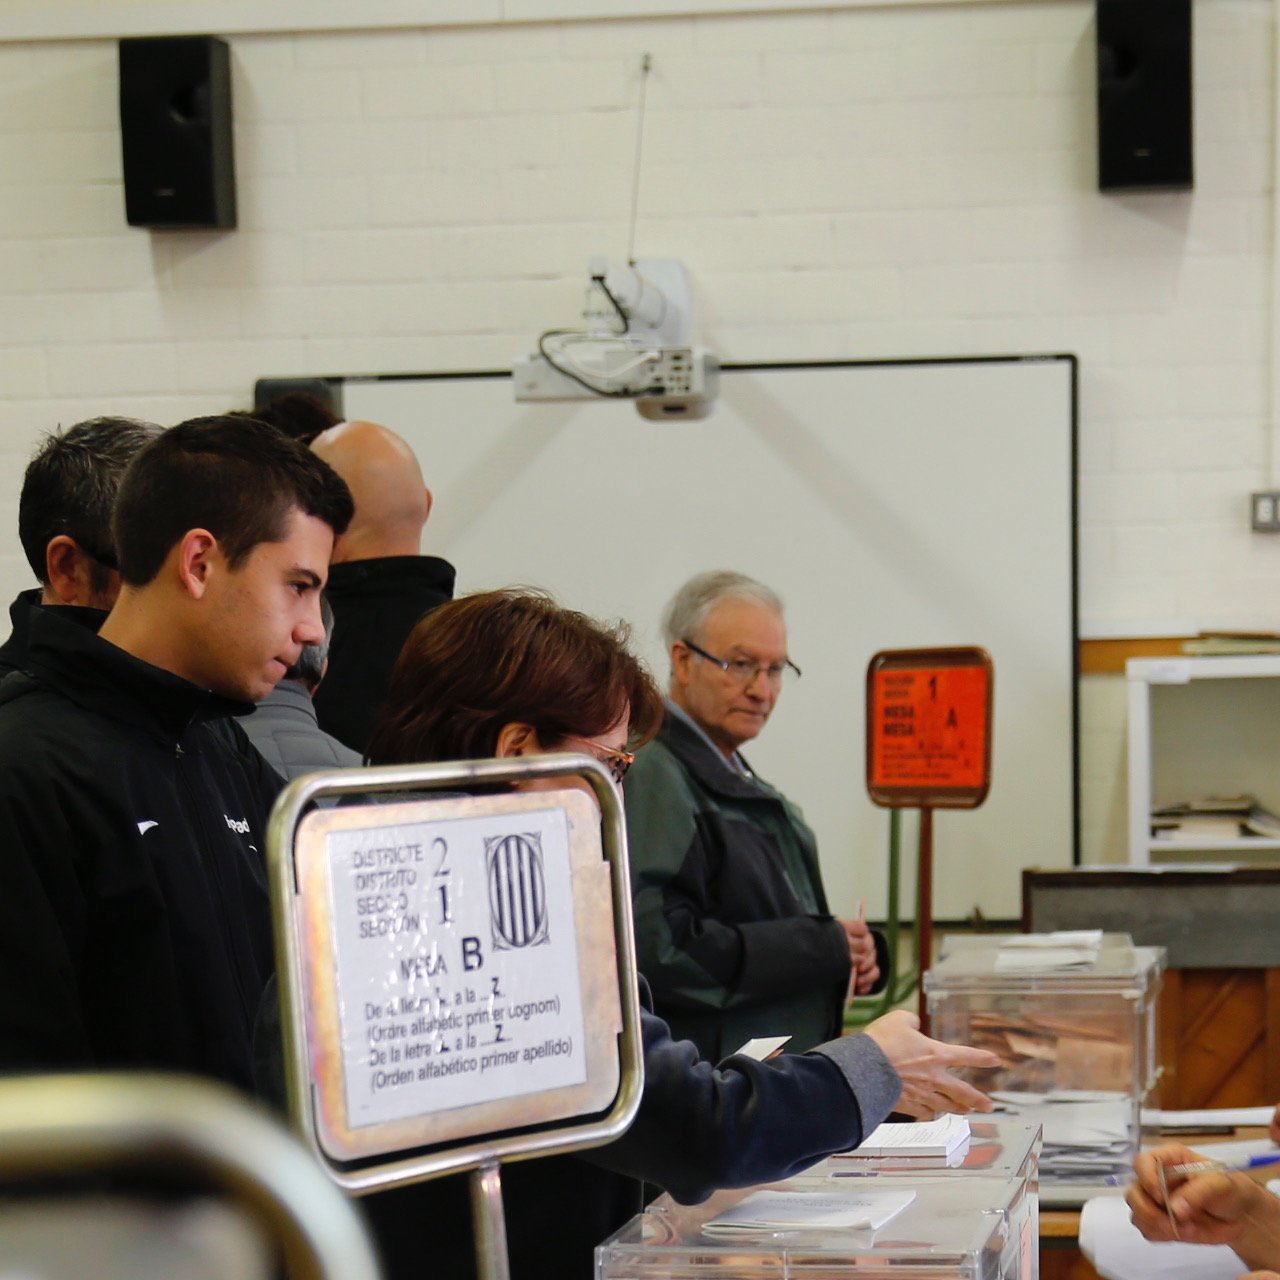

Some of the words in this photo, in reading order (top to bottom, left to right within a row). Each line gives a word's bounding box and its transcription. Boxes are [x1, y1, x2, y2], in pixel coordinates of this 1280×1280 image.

[353, 844, 424, 869] DISTRICTE
[432, 836, 451, 877] 2
[356, 868, 417, 891] DISTRITO
[438, 884, 454, 925] 1
[461, 936, 484, 972] B
[481, 1049, 519, 1074] primer
[523, 1036, 574, 1064] apellido)
